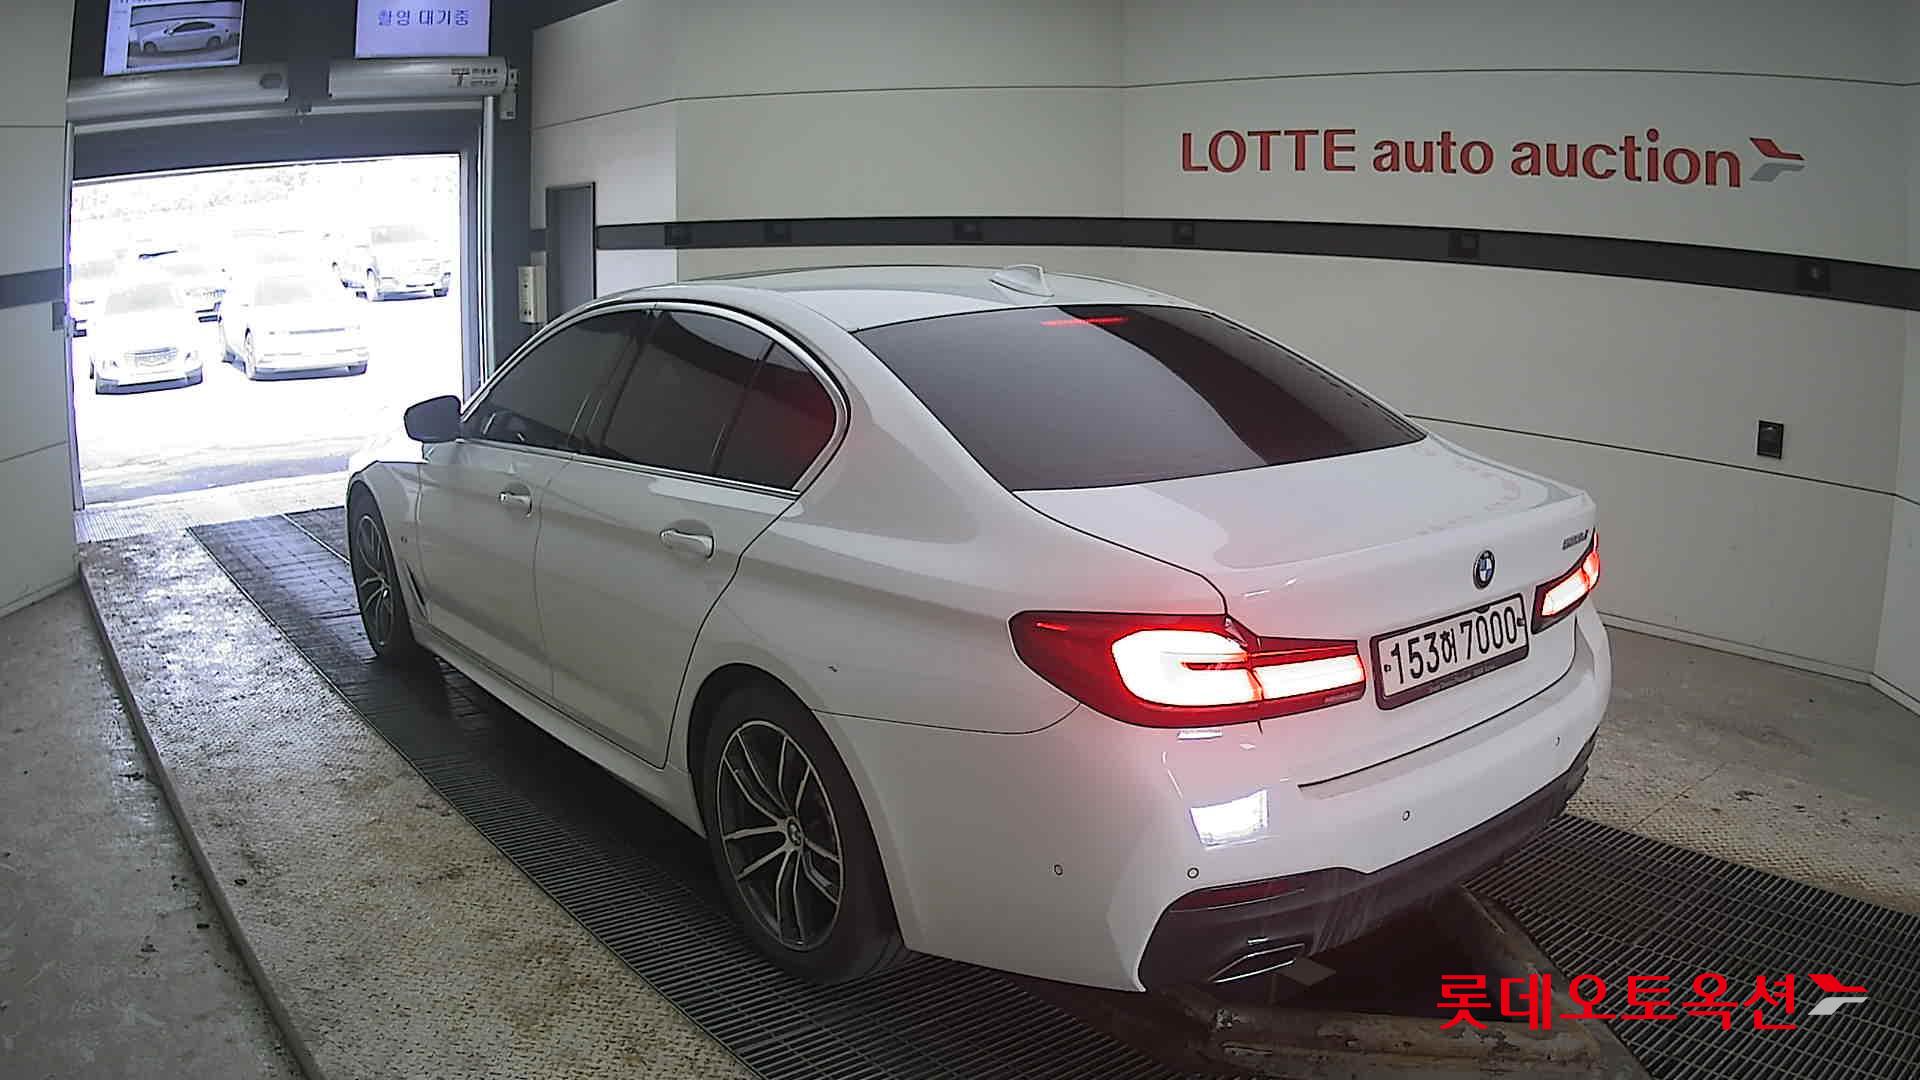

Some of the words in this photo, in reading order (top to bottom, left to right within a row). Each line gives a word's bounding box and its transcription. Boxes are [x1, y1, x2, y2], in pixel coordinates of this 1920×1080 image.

[419, 9, 470, 26] 대기중
[1181, 128, 1357, 173] LOTTE
[1372, 130, 1495, 176] auto
[1510, 128, 1742, 188] auction
[1390, 628, 1458, 685] 153허
[1460, 606, 1518, 660] 7000
